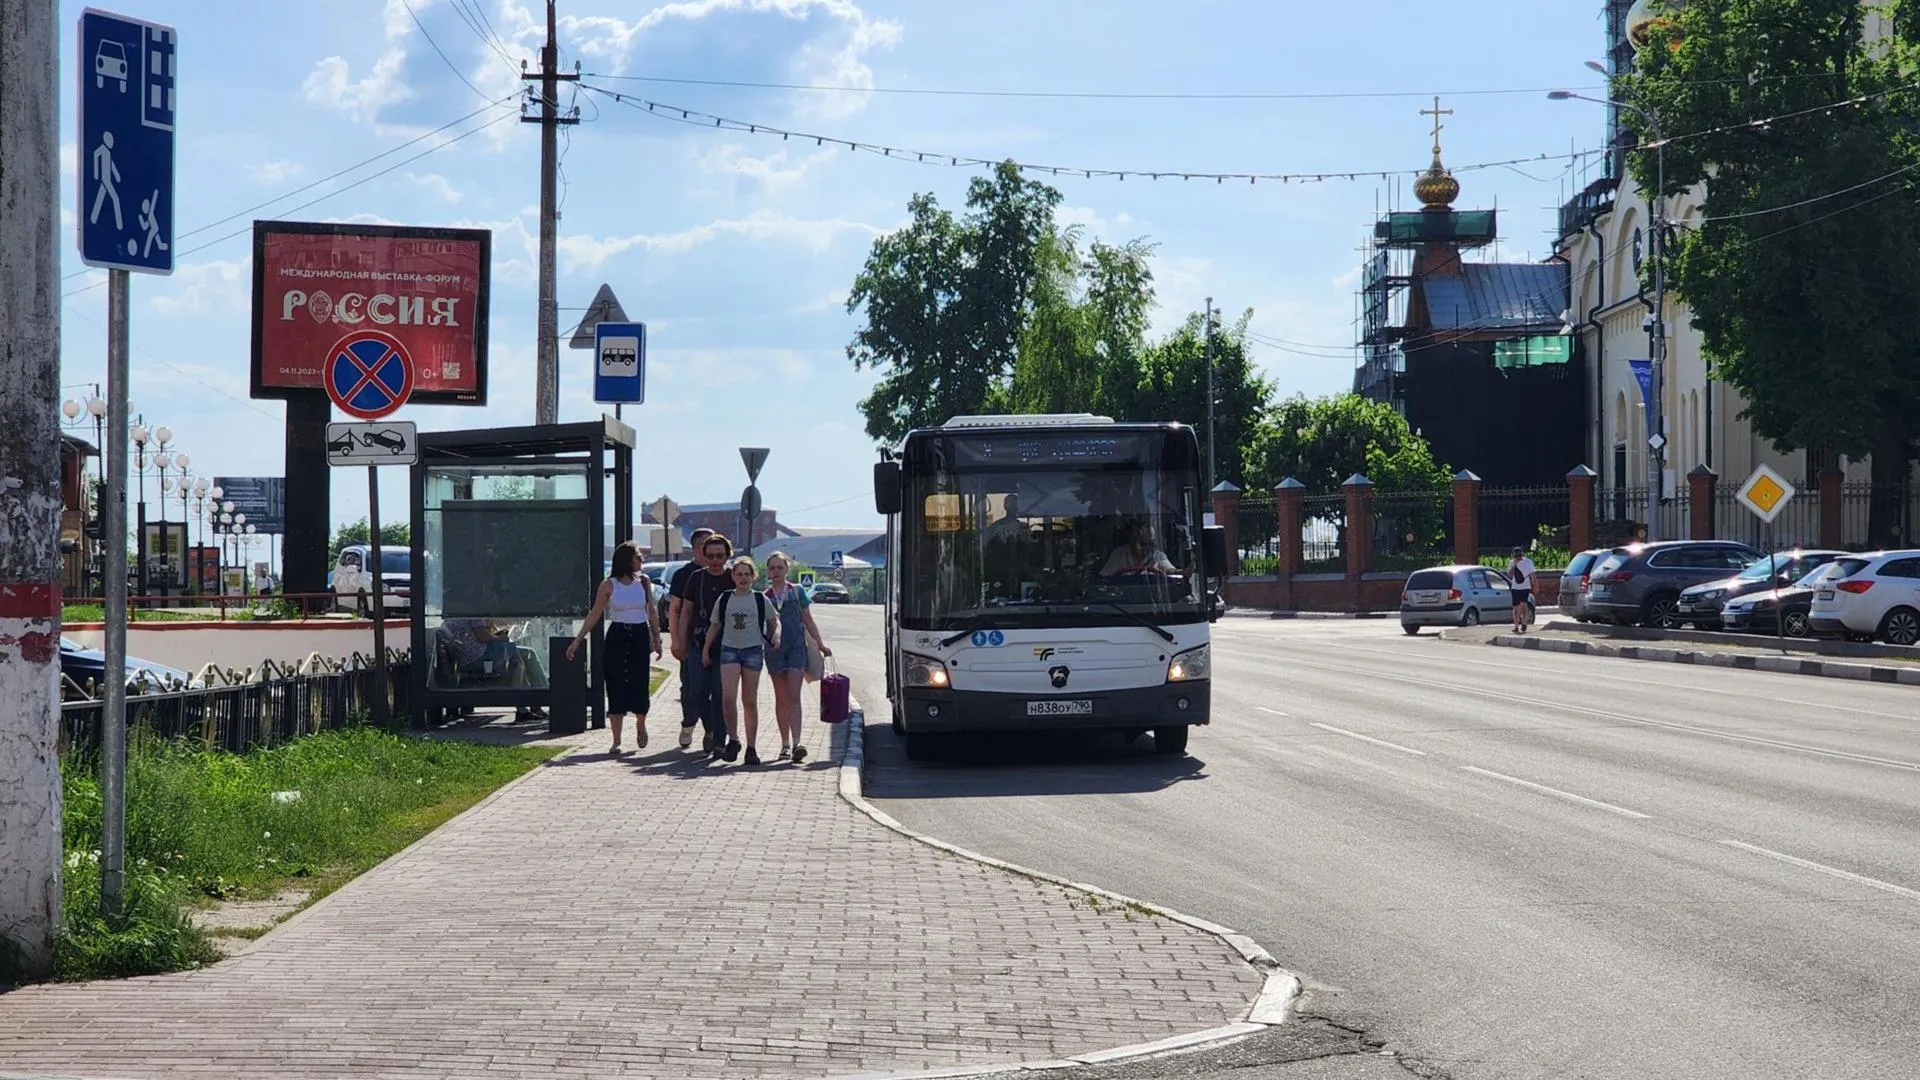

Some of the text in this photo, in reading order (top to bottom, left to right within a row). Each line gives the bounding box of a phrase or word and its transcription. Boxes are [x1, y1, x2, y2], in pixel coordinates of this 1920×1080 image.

[280, 268, 461, 283] МЕЖДУНАРОДНАЯ ВЫСТАВКА-ФОРУМ
[280, 289, 461, 327] РОССИЯ
[422, 368, 438, 379] 0+
[1073, 701, 1090, 710] 790
